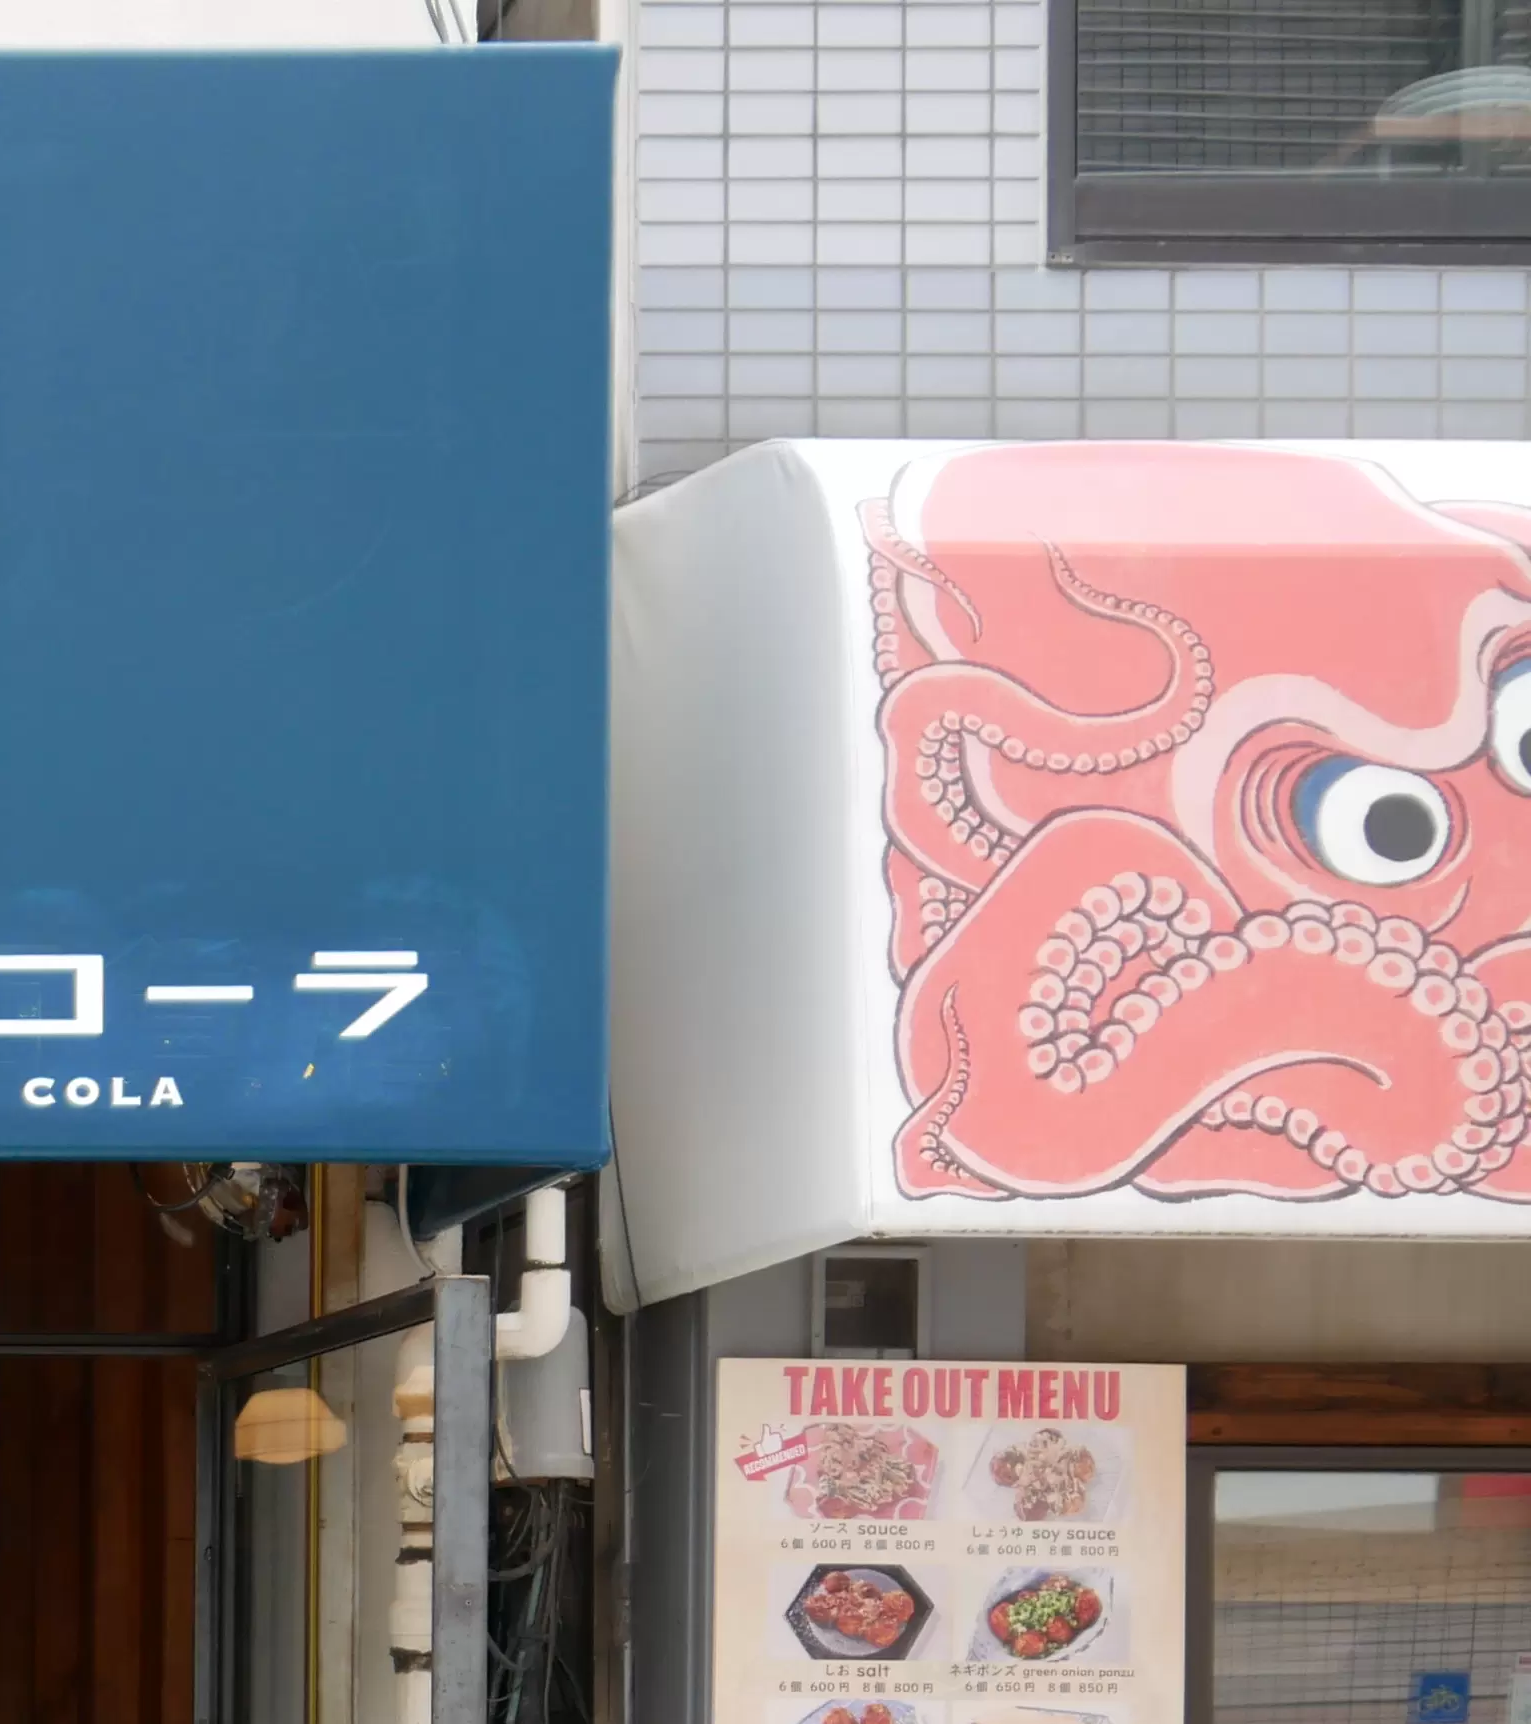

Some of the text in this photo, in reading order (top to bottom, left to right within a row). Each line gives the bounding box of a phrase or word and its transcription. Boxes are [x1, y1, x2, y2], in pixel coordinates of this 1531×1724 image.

[24, 1076, 185, 1107] COLA
[783, 1366, 1121, 1421] TAKE OUT MENU
[809, 1523, 908, 1536] ソース sauce
[972, 1526, 1116, 1542] しょうゆ soy sauce
[826, 1664, 891, 1677] しお salt
[1023, 1667, 1057, 1679] green
[1061, 1666, 1094, 1677] onion
